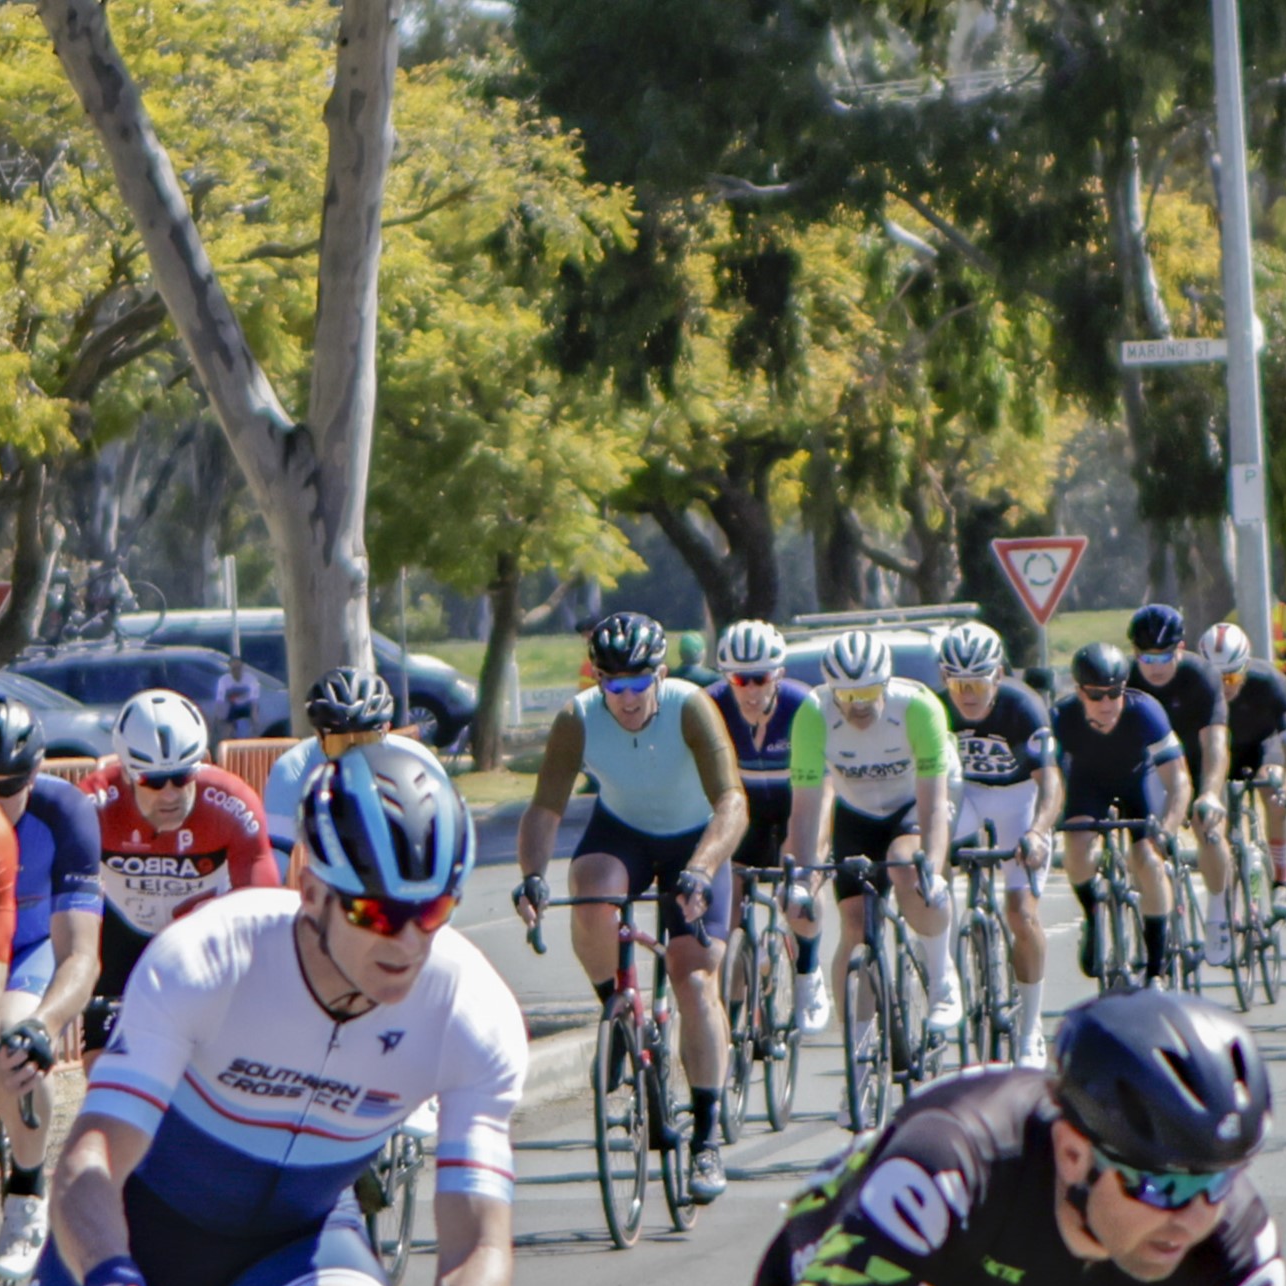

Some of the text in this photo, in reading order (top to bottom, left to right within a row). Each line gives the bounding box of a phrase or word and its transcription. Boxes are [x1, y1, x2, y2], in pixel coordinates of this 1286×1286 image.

[1126, 341, 1210, 359] MARUNGI ST
[217, 1071, 306, 1099] CROSS
